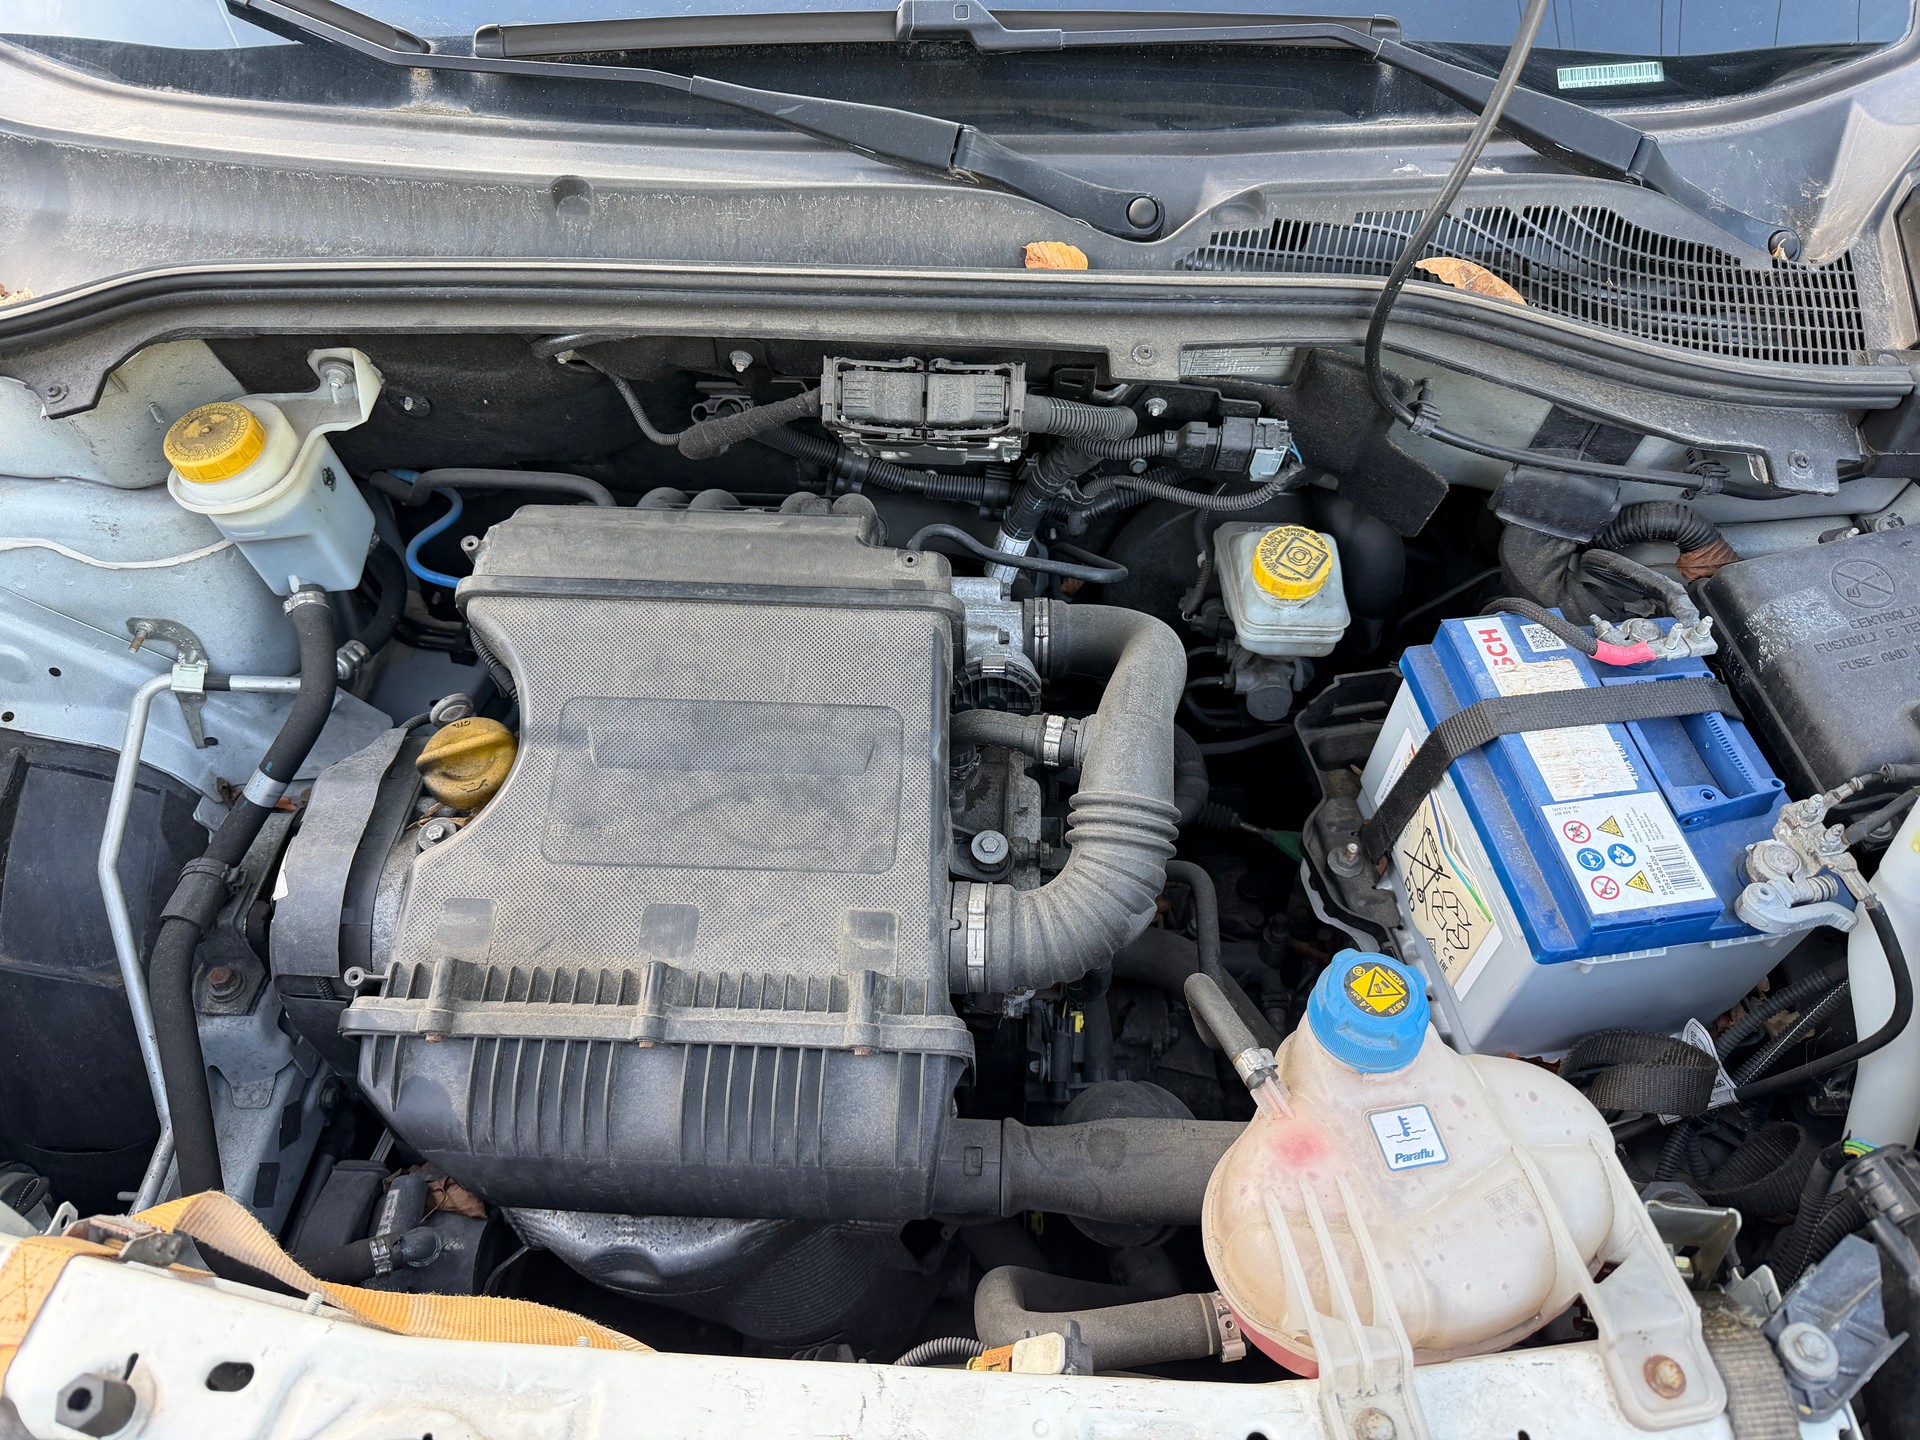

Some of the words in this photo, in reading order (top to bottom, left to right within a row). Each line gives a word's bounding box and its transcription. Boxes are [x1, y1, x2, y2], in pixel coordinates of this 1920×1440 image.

[1849, 606, 1920, 629] CENTRALI
[1885, 628, 1898, 638] E
[1837, 656, 1876, 672] FUSE
[1881, 648, 1908, 663] AND
[1405, 876, 1415, 912] Pb
[1351, 990, 1361, 1001] bar
[1360, 1001, 1372, 1013] 1.4
[1394, 1148, 1435, 1164] Paraflu
